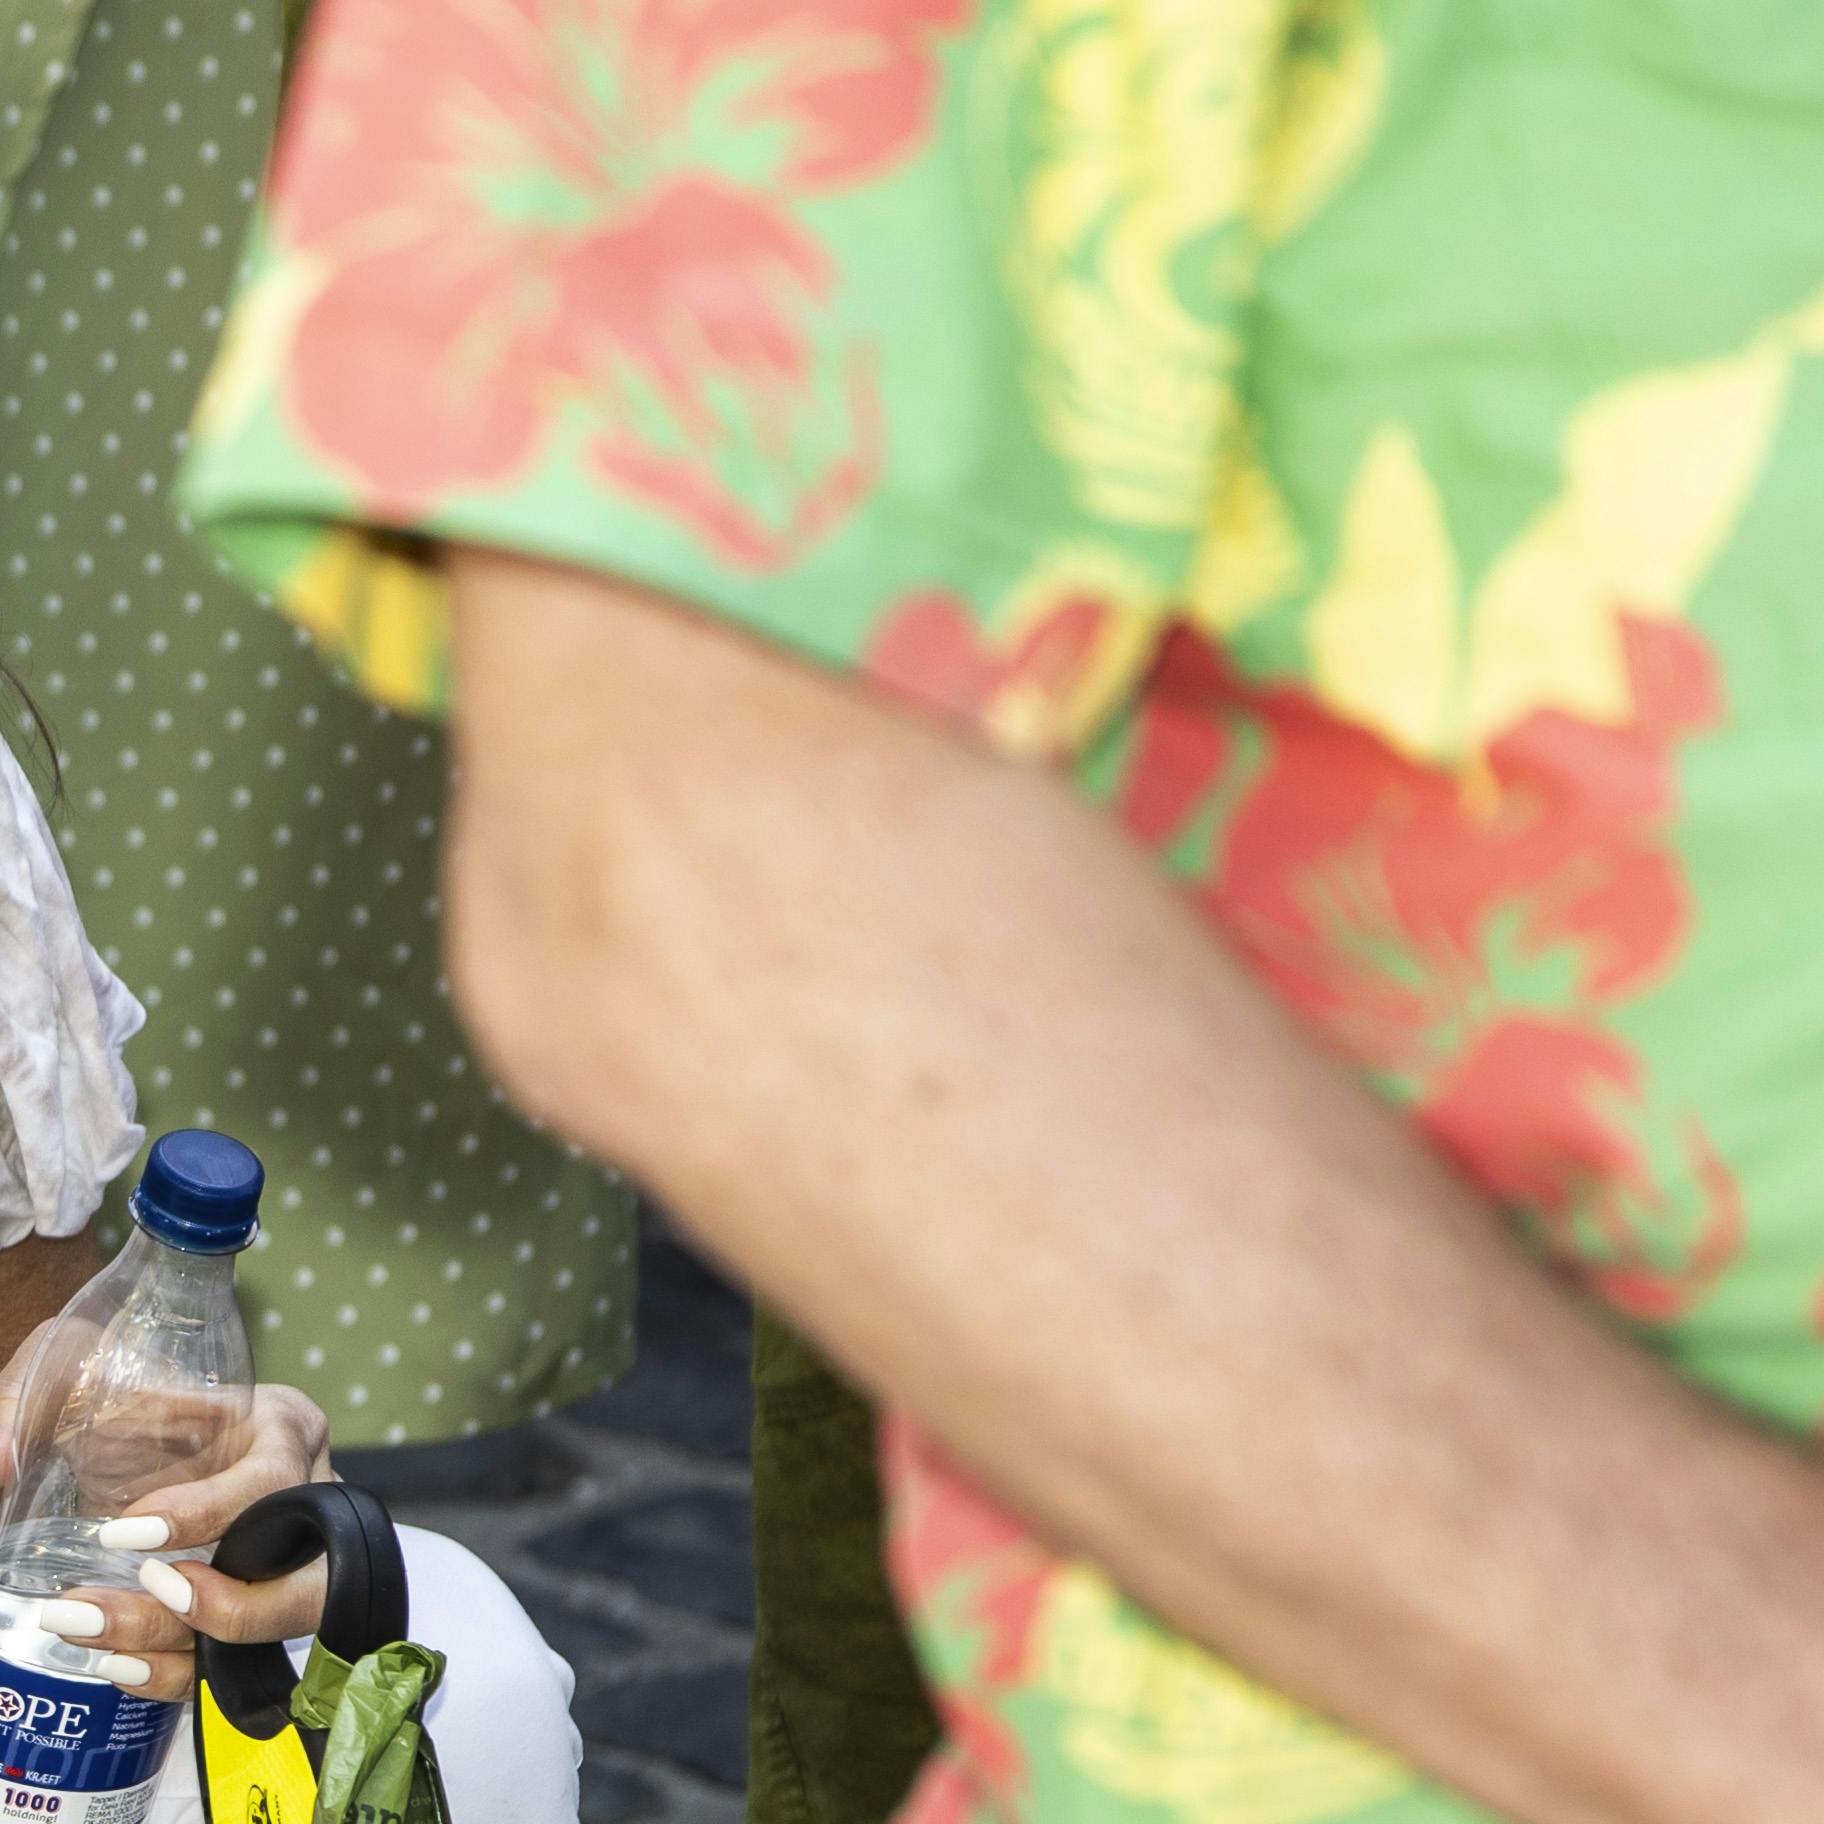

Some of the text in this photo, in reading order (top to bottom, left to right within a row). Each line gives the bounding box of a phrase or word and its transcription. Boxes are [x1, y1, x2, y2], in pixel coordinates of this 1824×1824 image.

[115, 1712, 147, 1720] Calcium
[112, 1721, 145, 1730] Natrium
[15, 1731, 82, 1751] POSSIBLE
[109, 1729, 154, 1741] Magnesium
[25, 1770, 61, 1785] KRÆFT
[4, 1786, 63, 1814] 1000
[3, 1807, 58, 1824] holdning!
